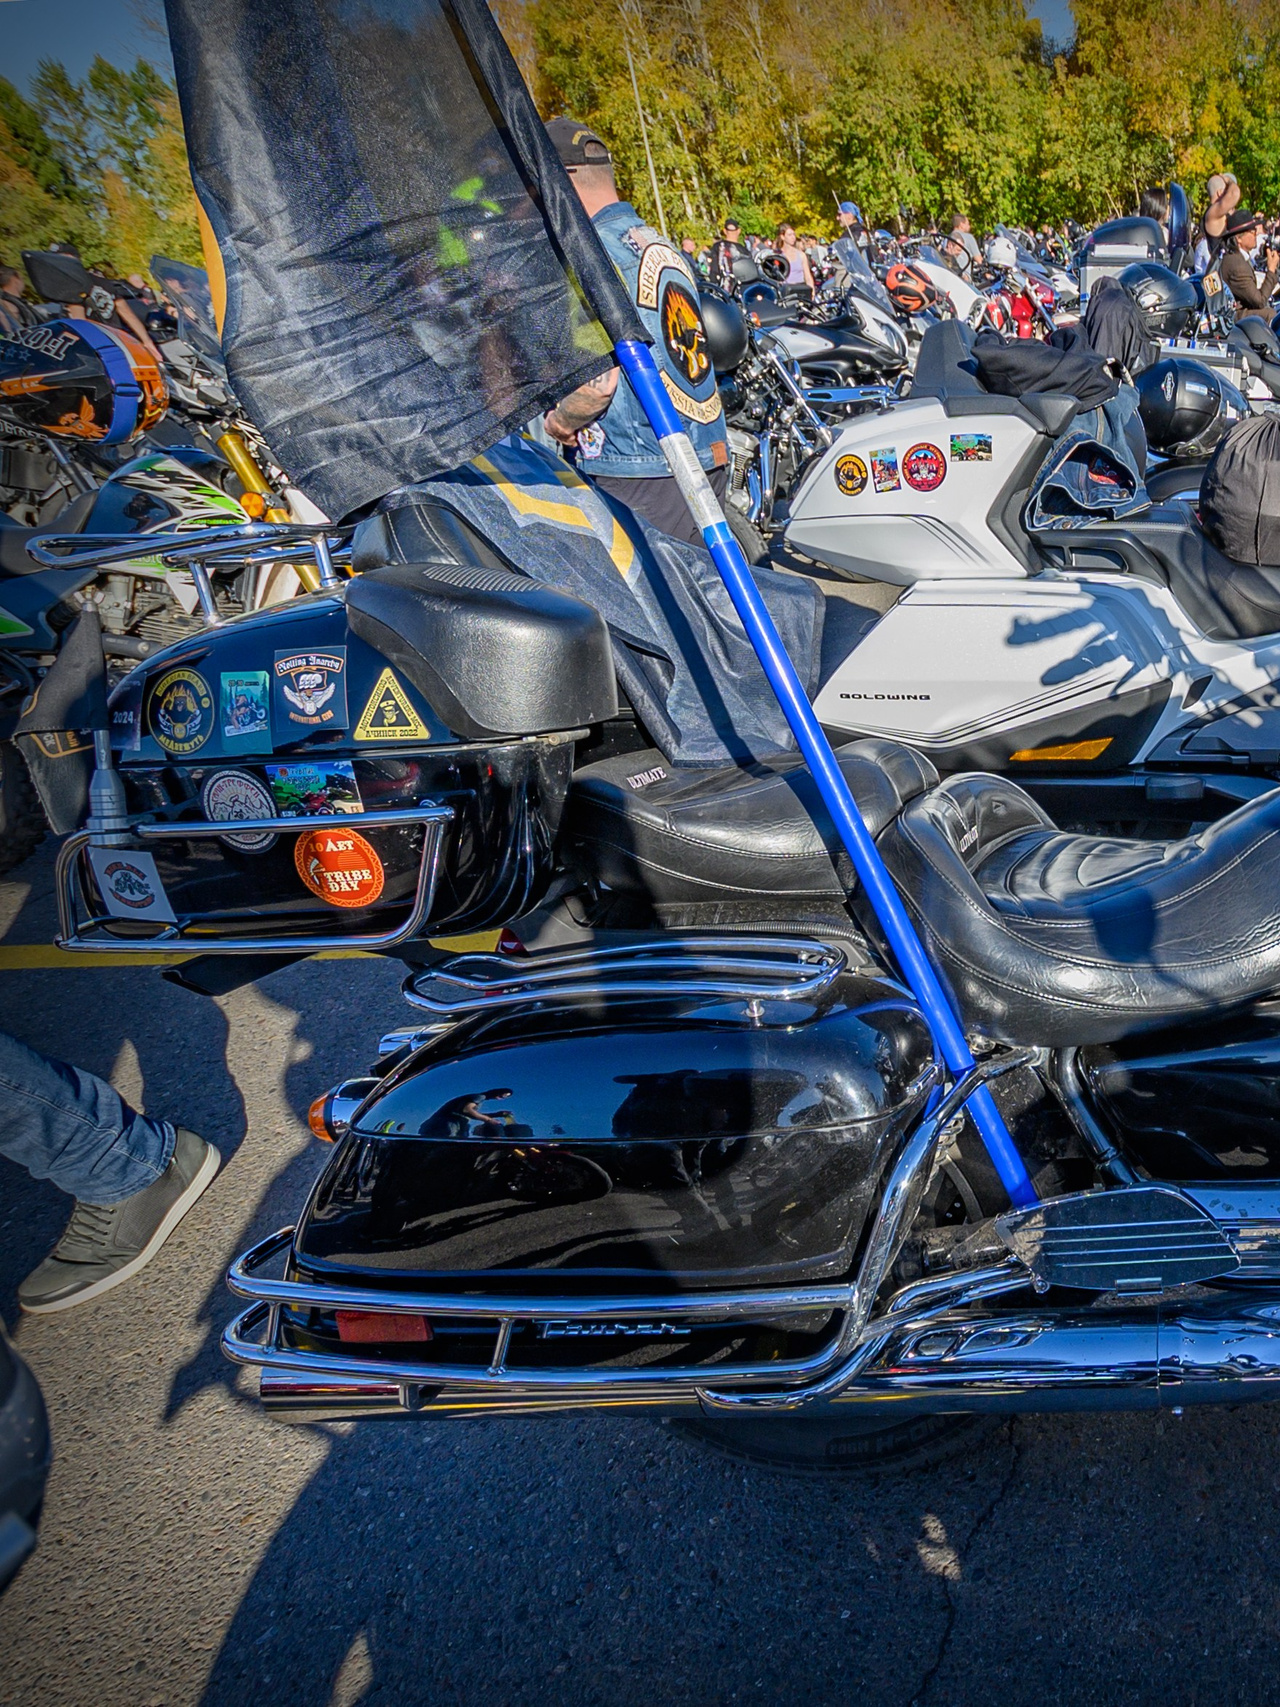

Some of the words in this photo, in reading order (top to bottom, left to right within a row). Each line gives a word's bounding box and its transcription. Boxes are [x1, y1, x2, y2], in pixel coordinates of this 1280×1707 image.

[839, 693, 931, 701] GOLDWING
[626, 766, 667, 789] ULTIMATE
[324, 868, 373, 883] TRIBE
[327, 880, 361, 893] DAY
